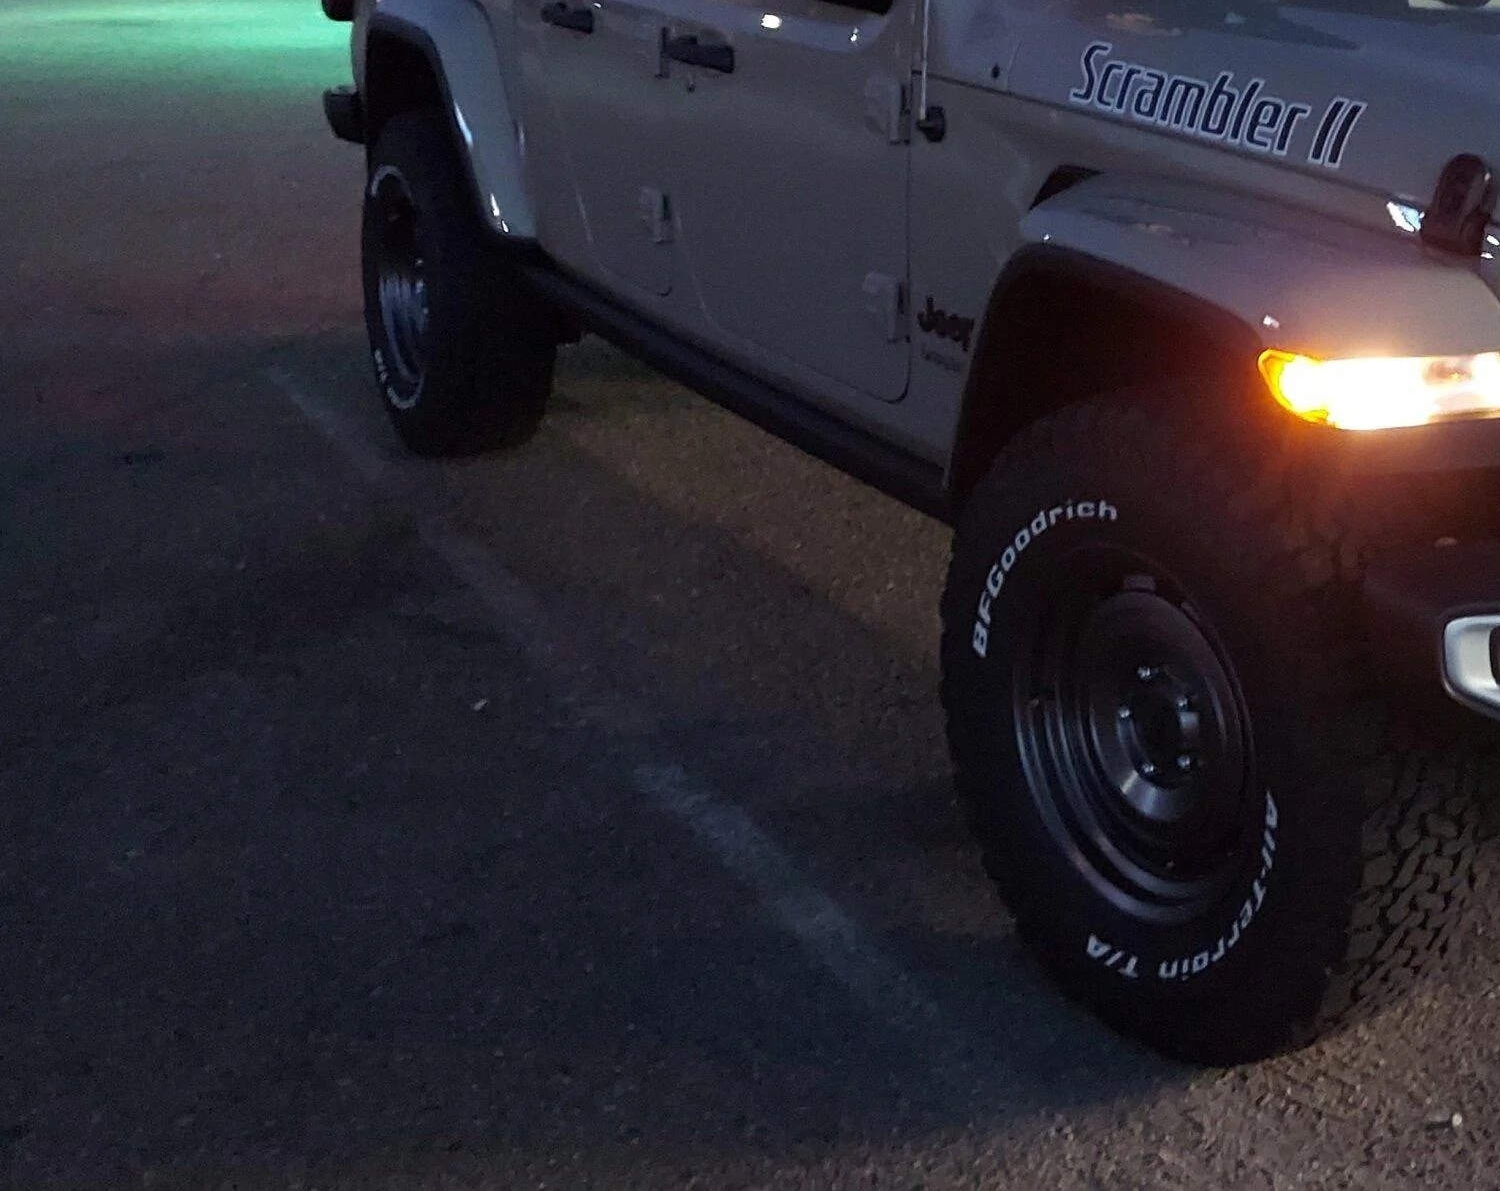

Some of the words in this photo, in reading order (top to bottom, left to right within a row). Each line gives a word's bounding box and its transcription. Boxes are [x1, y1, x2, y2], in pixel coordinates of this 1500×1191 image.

[1072, 43, 1308, 155] Scrambler
[970, 498, 1118, 659] BFGoodrich
[1085, 932, 1139, 979] T/A
